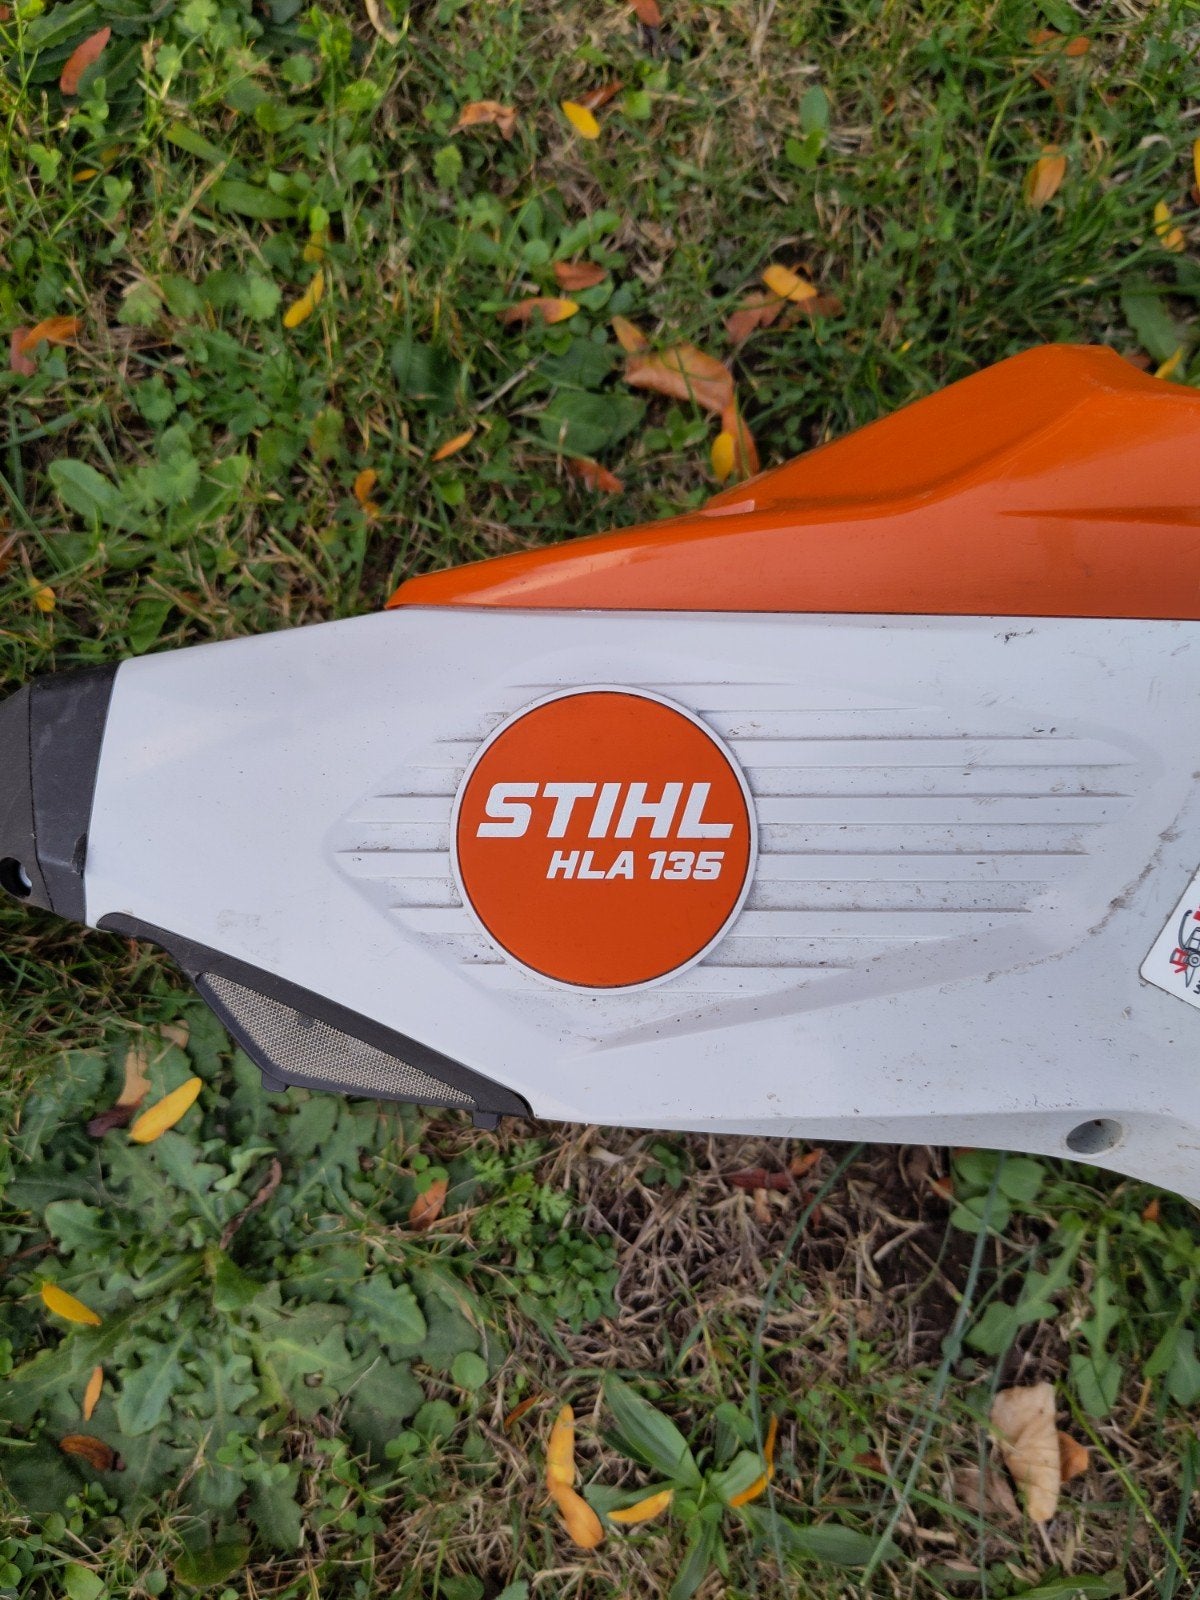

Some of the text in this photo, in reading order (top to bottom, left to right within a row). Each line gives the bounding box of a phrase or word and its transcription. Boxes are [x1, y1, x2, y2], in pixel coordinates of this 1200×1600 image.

[476, 782, 734, 839] STIHL
[546, 850, 725, 880] HLA 135
